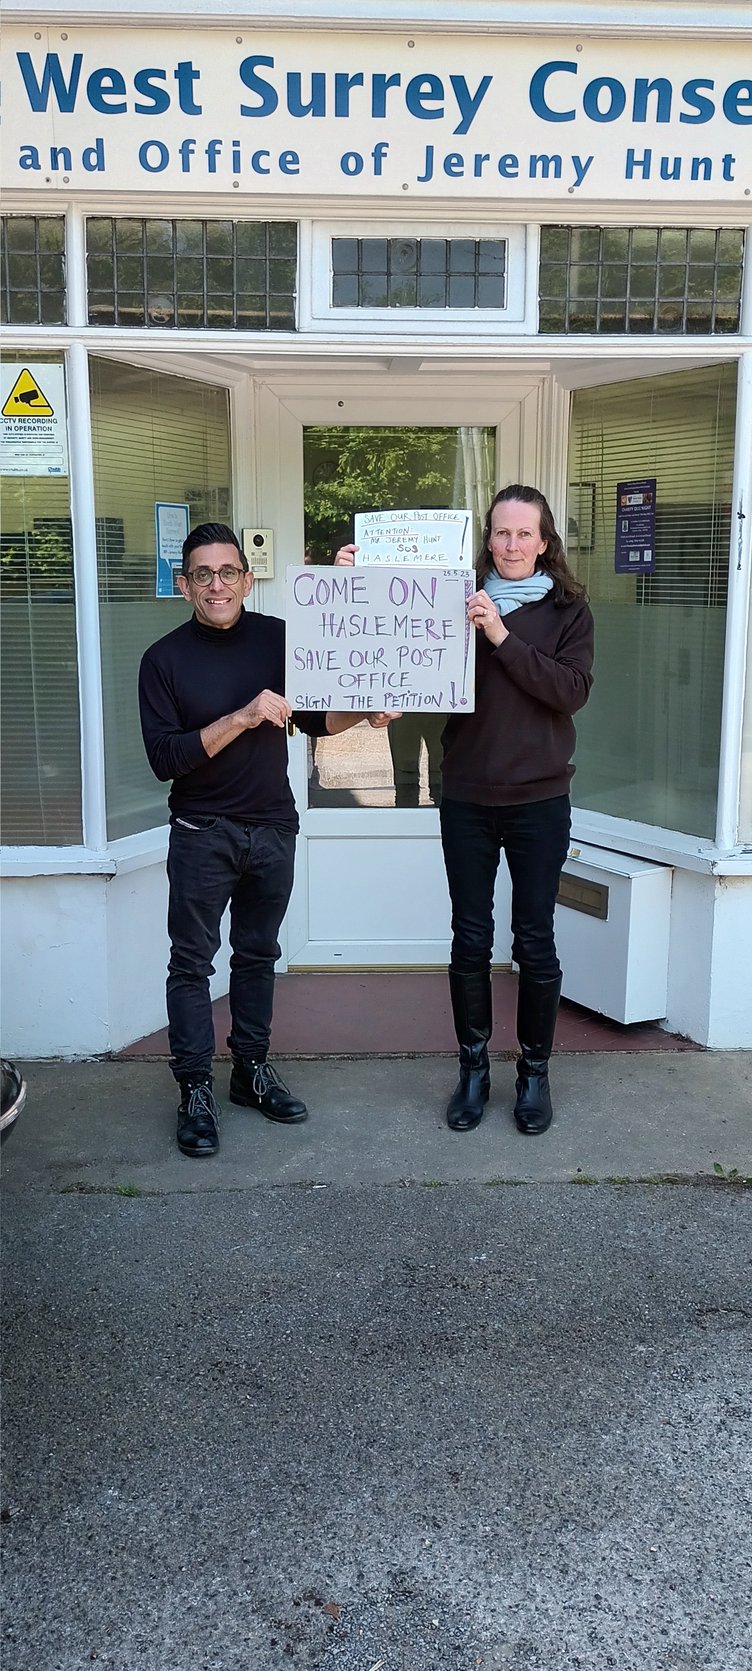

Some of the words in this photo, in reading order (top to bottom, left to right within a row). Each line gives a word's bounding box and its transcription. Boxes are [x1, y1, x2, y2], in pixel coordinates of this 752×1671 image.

[16, 51, 204, 116] West
[239, 54, 494, 135] Surrey
[528, 60, 752, 125] Conse
[18, 137, 106, 172] and
[138, 138, 301, 175] Office
[340, 141, 389, 177] of
[416, 144, 595, 187] Jeremy
[624, 147, 737, 181] Hunt
[364, 513, 385, 524] SAVE
[390, 512, 410, 521] OUR
[432, 512, 460, 521] OFFICE
[423, 535, 442, 544] HUNT
[362, 553, 448, 562] HASLEMERE
[293, 572, 369, 607] COME
[388, 576, 437, 609] ON
[319, 612, 457, 640] HASLEMERE
[293, 646, 341, 671] SAVE
[349, 647, 388, 668] OUR
[396, 645, 447, 671] POST
[338, 672, 413, 689] OFFICE
[344, 694, 373, 709] THE
